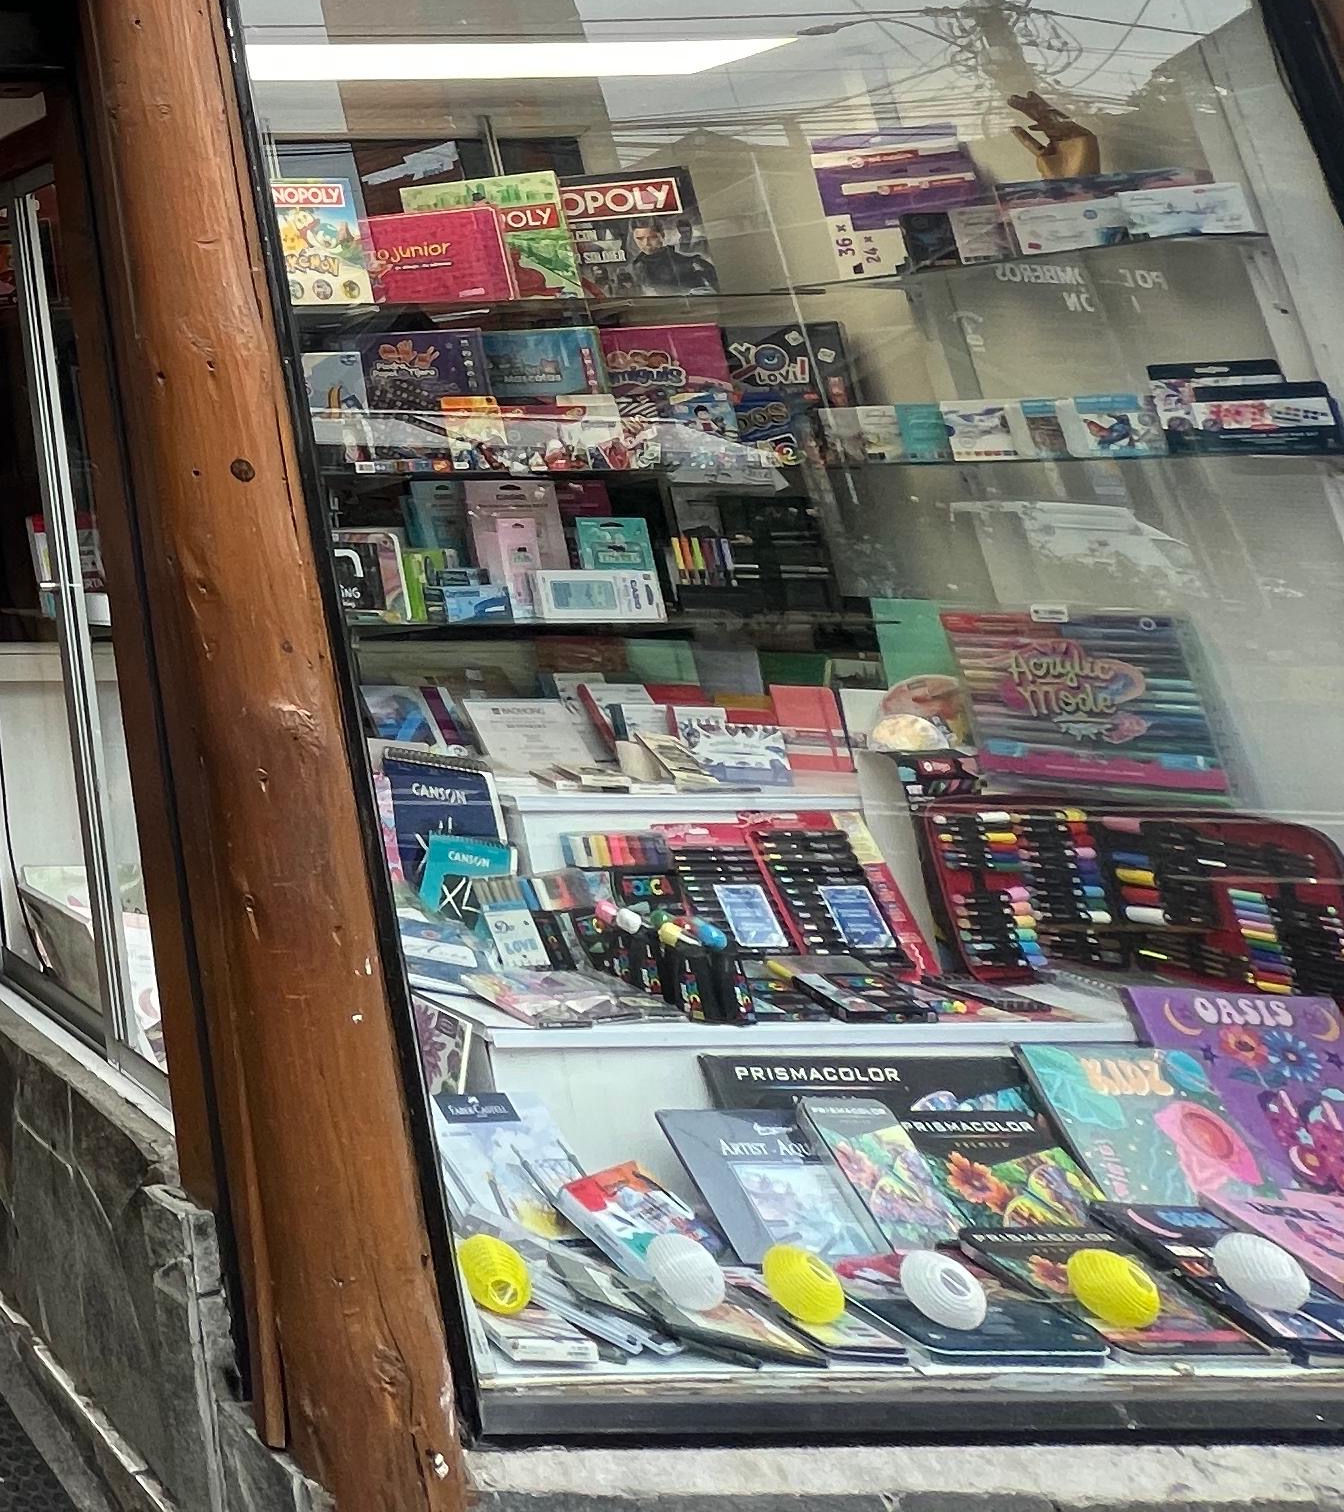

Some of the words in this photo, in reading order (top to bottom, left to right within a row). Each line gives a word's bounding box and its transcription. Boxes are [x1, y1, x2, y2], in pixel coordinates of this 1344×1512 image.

[273, 187, 341, 204] NOPOLY
[562, 184, 669, 216] OPOLY
[412, 782, 467, 805] CANSON
[448, 849, 491, 868] CANSON
[438, 876, 480, 918] XL
[1193, 996, 1295, 1028] OASIS
[734, 1065, 901, 1083] PRISMACOLOR
[902, 1120, 1037, 1133] PRISMACOLOR
